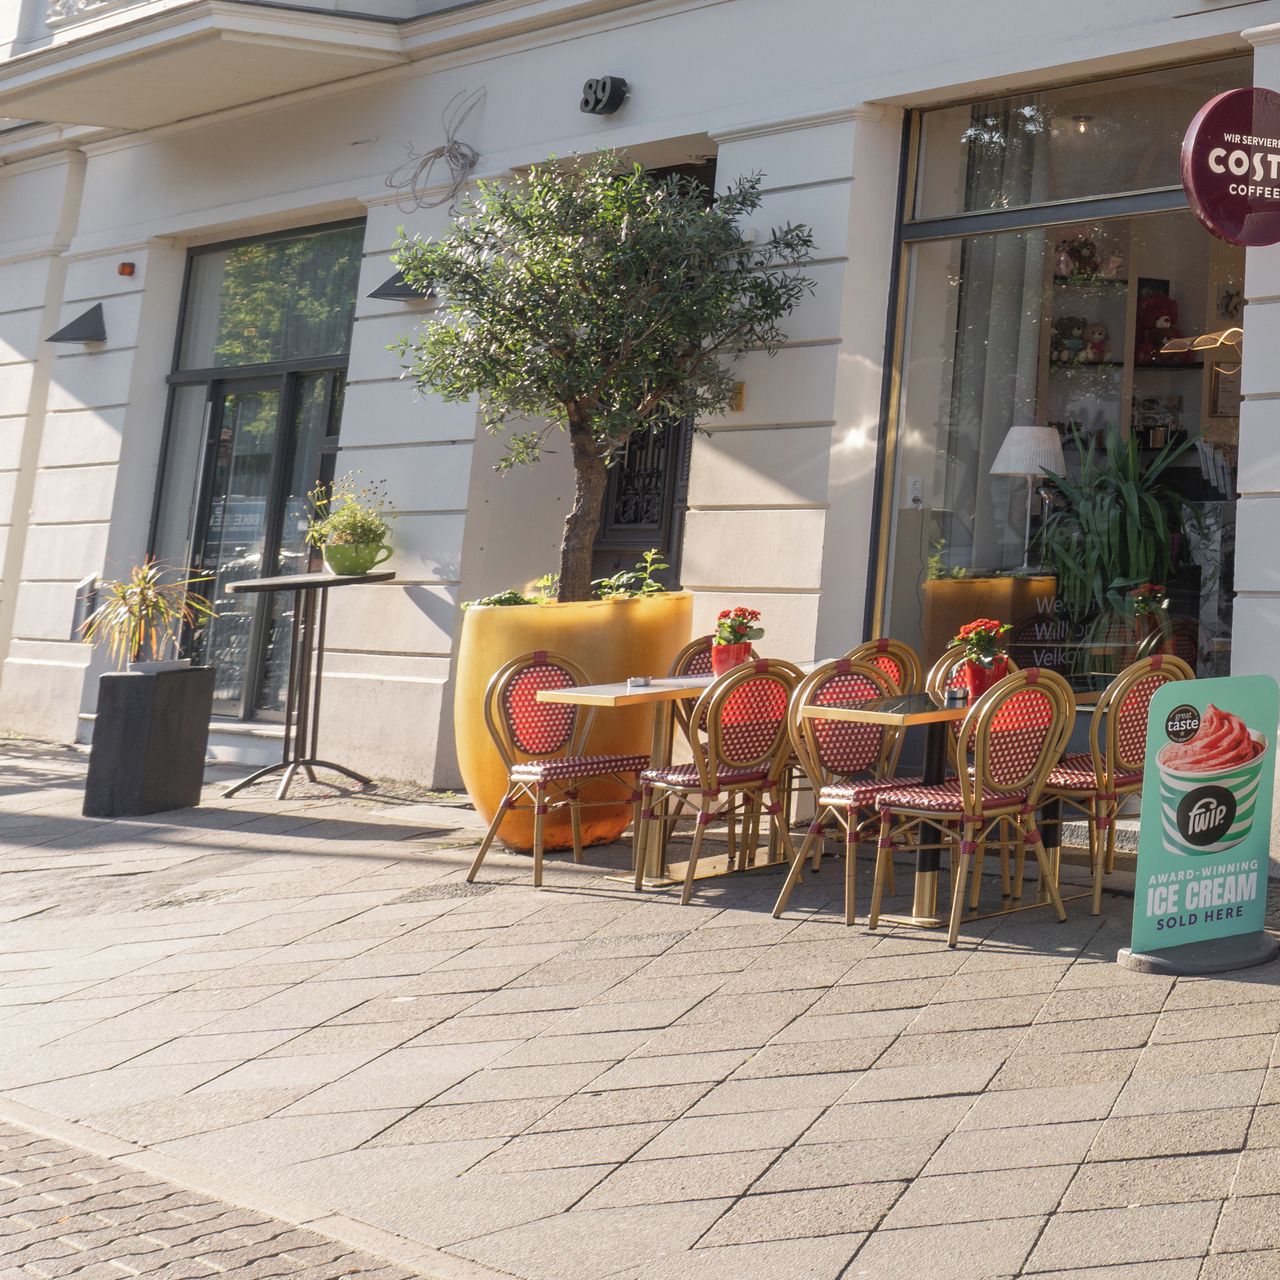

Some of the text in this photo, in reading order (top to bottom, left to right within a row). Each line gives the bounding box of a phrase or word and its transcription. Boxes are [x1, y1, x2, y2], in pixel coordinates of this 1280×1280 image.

[580, 75, 613, 114] 89
[1223, 132, 1241, 144] WIR
[1167, 718, 1199, 732] taste
[1174, 711, 1193, 722] great
[1148, 859, 1259, 886] AWARD-WINNING
[1146, 871, 1258, 918] ICE CREAM
[1156, 905, 1244, 931] SOLD HERE
